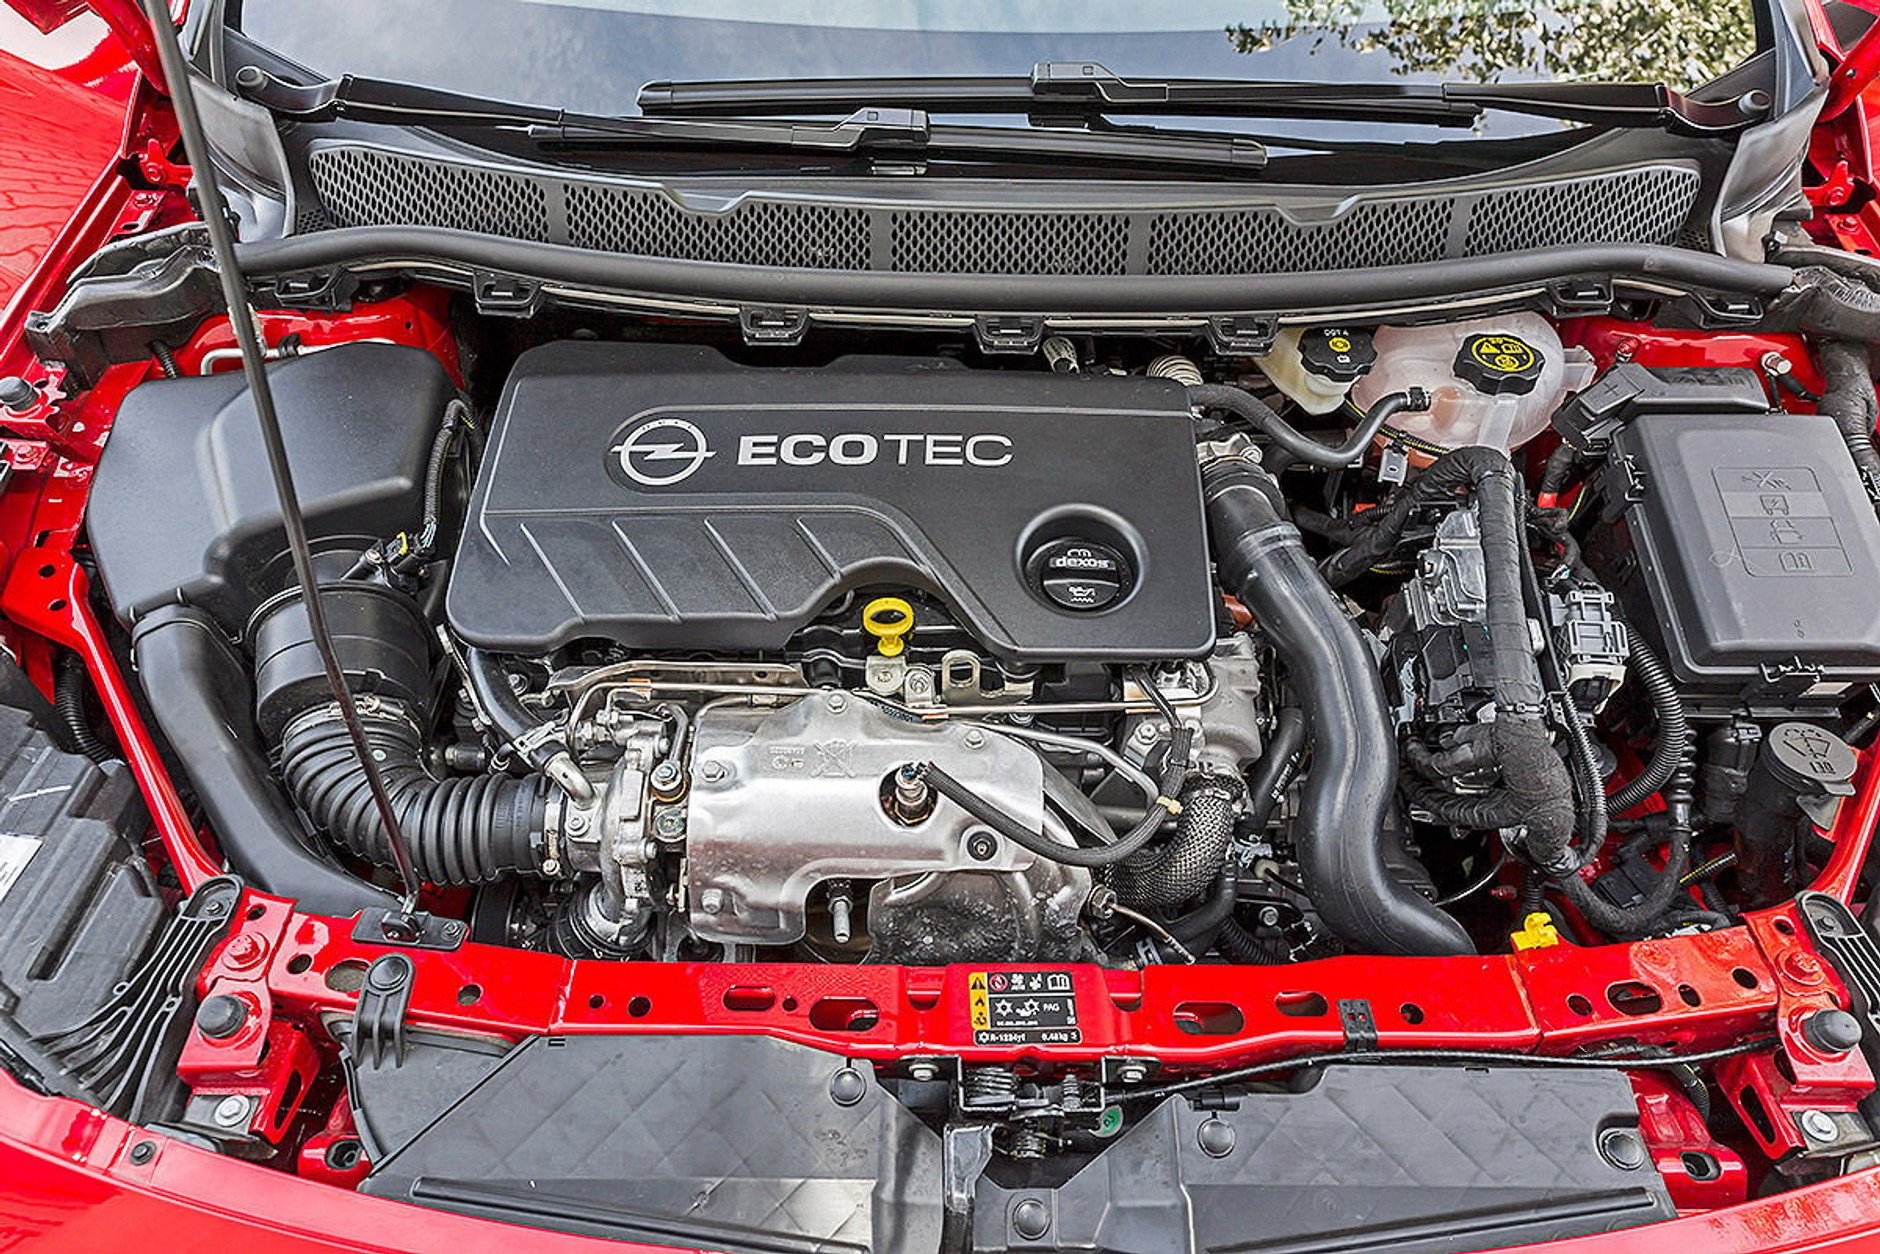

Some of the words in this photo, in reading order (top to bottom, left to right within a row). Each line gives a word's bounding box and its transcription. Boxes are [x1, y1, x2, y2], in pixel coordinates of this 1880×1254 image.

[737, 434, 1013, 466] ECOTEC
[1055, 556, 1110, 569] dexos
[1043, 1003, 1060, 1012] PAG
